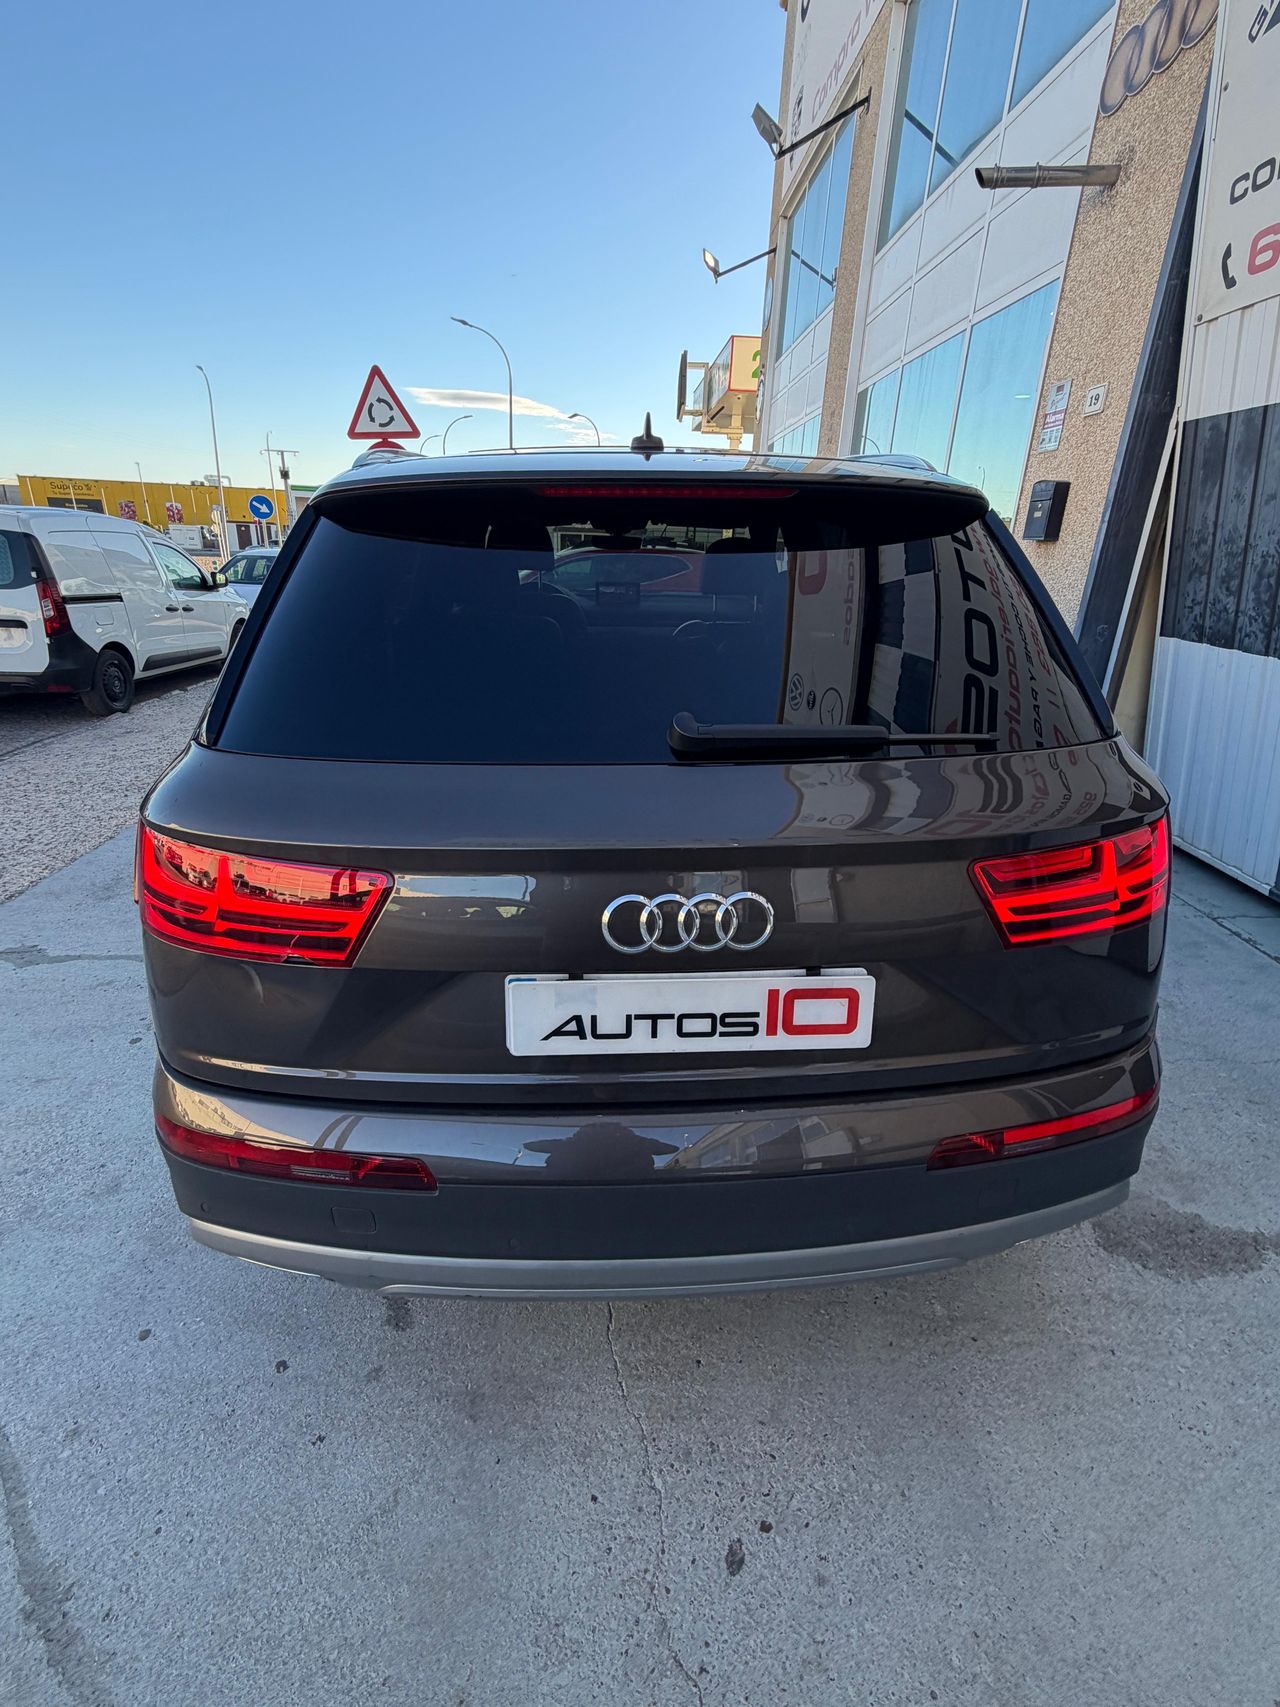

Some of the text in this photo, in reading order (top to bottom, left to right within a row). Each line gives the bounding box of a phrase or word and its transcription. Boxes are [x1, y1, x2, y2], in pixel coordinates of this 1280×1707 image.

[812, 10, 862, 124] Compra
[1229, 156, 1280, 206] CO
[1087, 392, 1100, 408] 19
[539, 987, 861, 1041] AUTOS10
